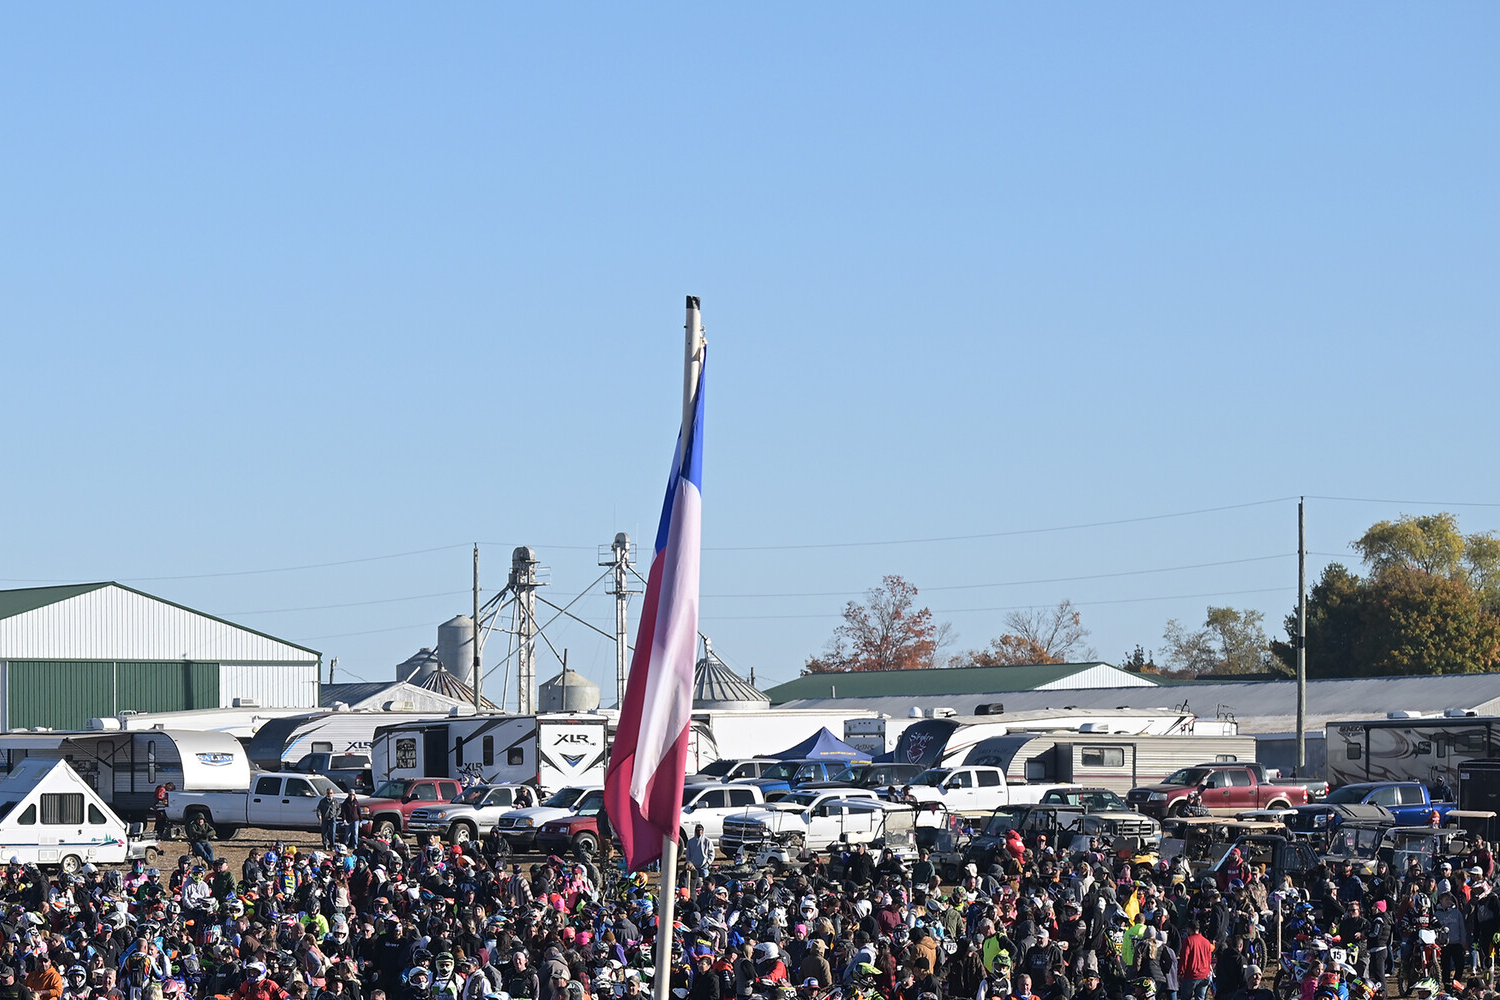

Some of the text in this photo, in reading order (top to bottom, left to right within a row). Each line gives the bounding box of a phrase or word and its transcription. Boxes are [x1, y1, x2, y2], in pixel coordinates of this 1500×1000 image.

[553, 734, 589, 746] XLR
[345, 741, 373, 751] XLR
[464, 762, 483, 771] XLR
[1332, 951, 1342, 960] 15
